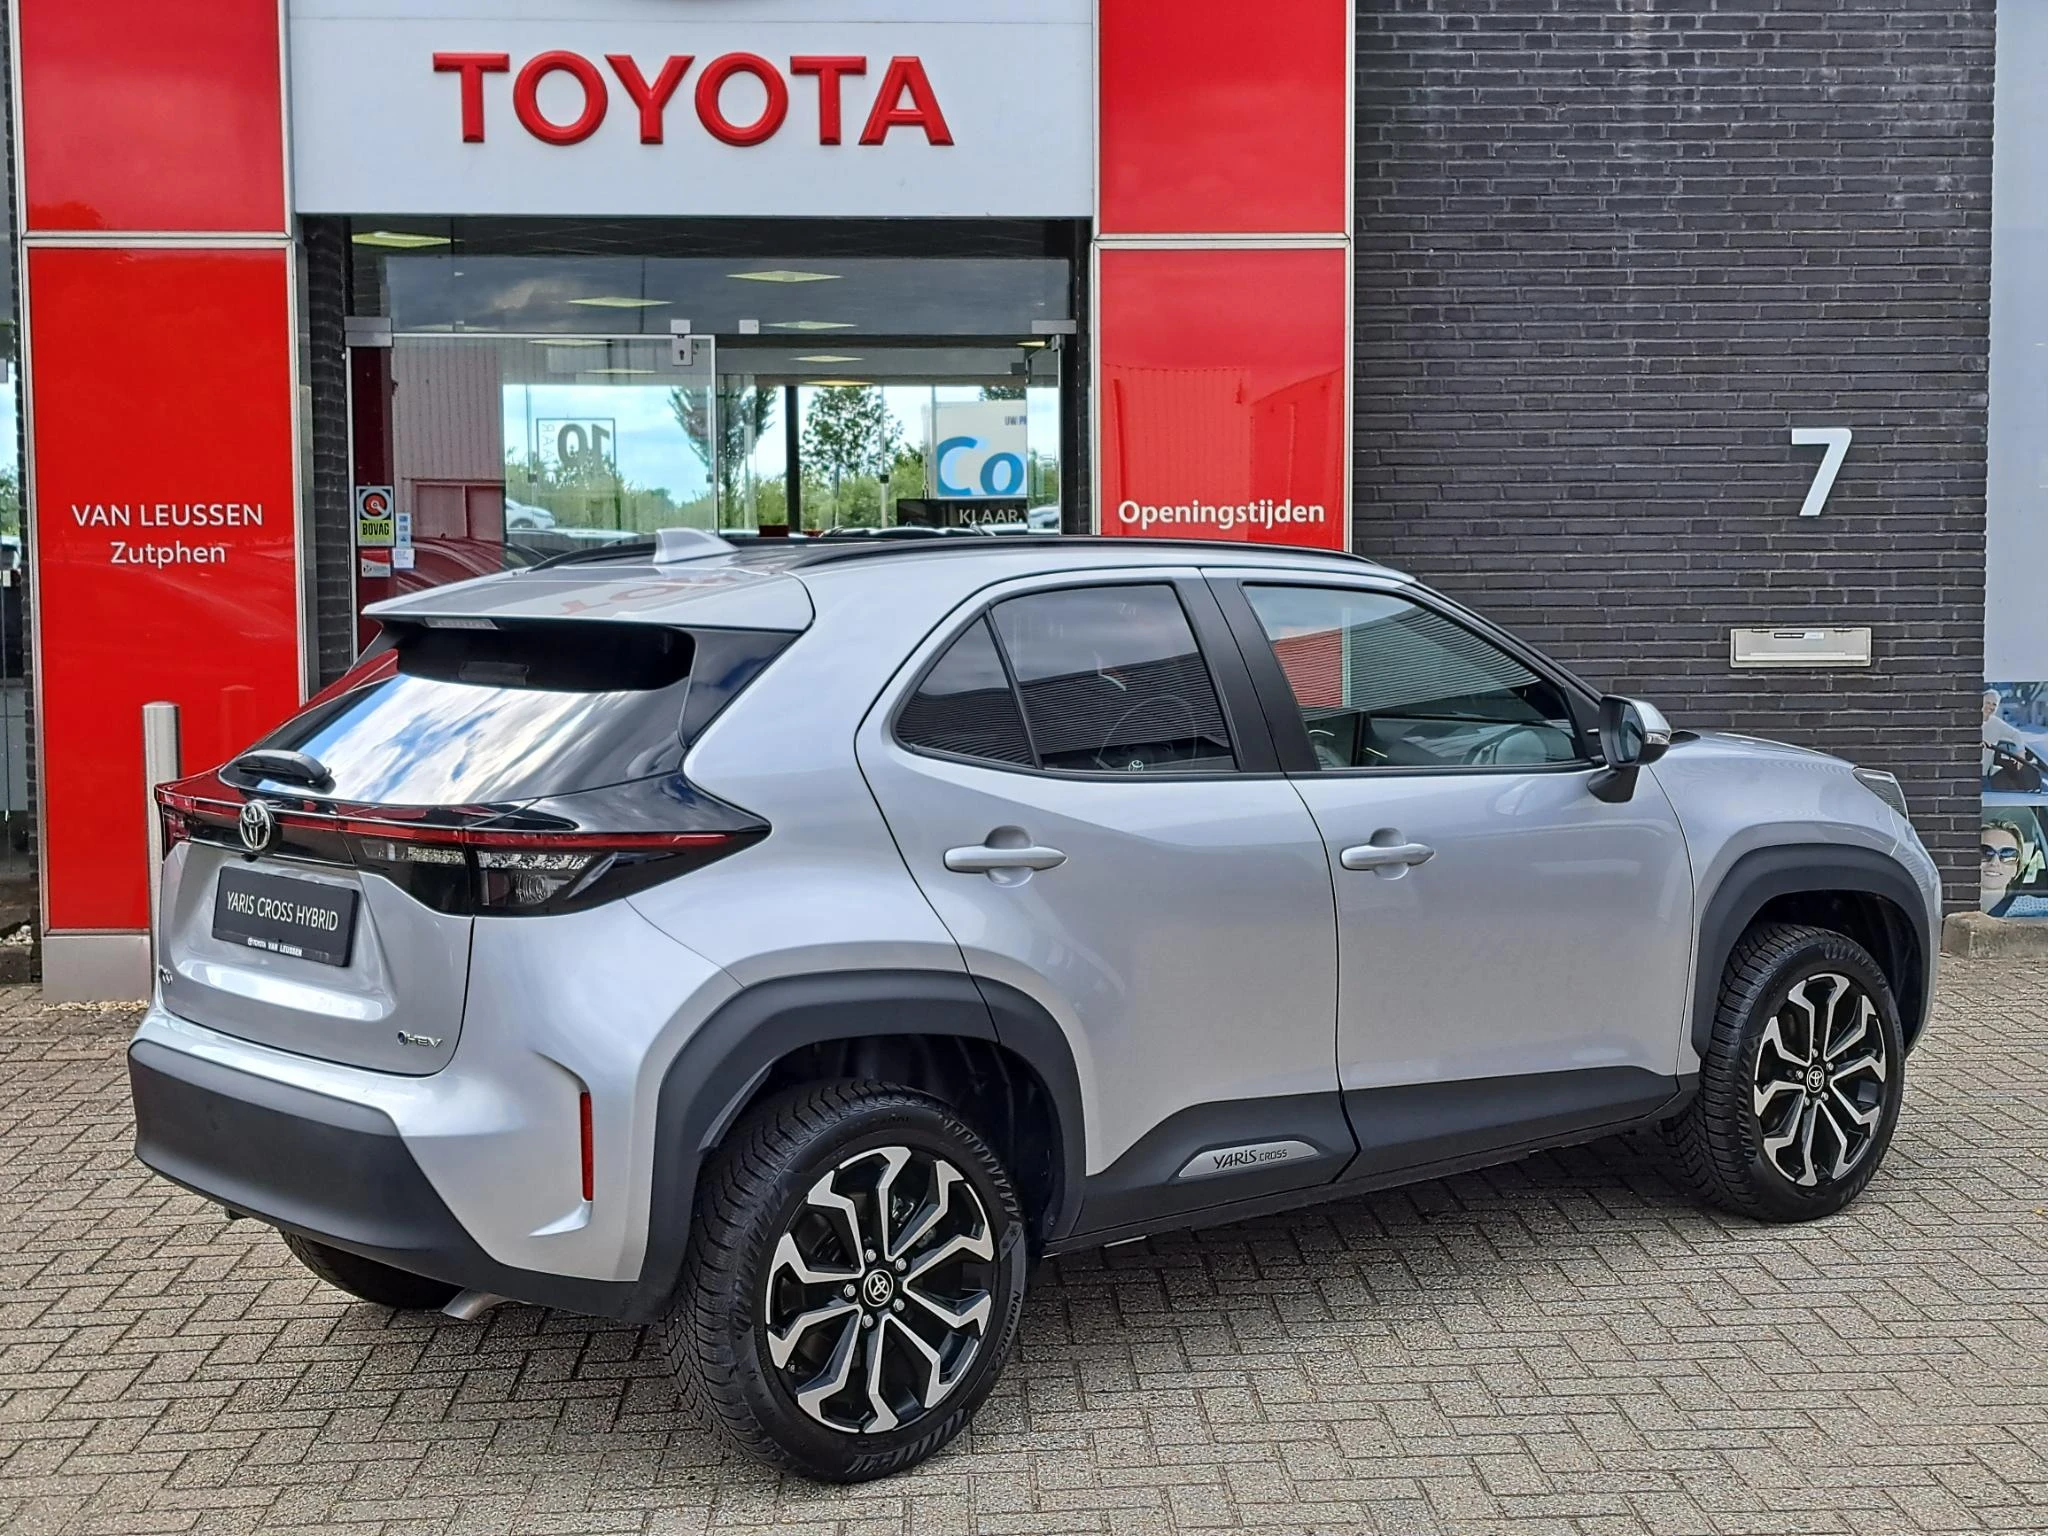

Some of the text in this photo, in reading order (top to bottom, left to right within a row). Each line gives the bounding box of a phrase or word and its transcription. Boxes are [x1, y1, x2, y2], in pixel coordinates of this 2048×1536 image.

[433, 50, 955, 147] TOYOTA
[936, 436, 1025, 497] Co
[1792, 428, 1853, 517] 7
[72, 503, 263, 527] VAN LEUSSEN
[362, 522, 390, 536] BOVAG
[1118, 499, 1325, 530] Openingstijden
[110, 540, 226, 569] Zutphen
[227, 891, 339, 932] YARIS CROSS HYBRID
[268, 942, 278, 951] VAN
[280, 944, 303, 957] LEUSSEN
[1259, 1149, 1288, 1162] CROSS
